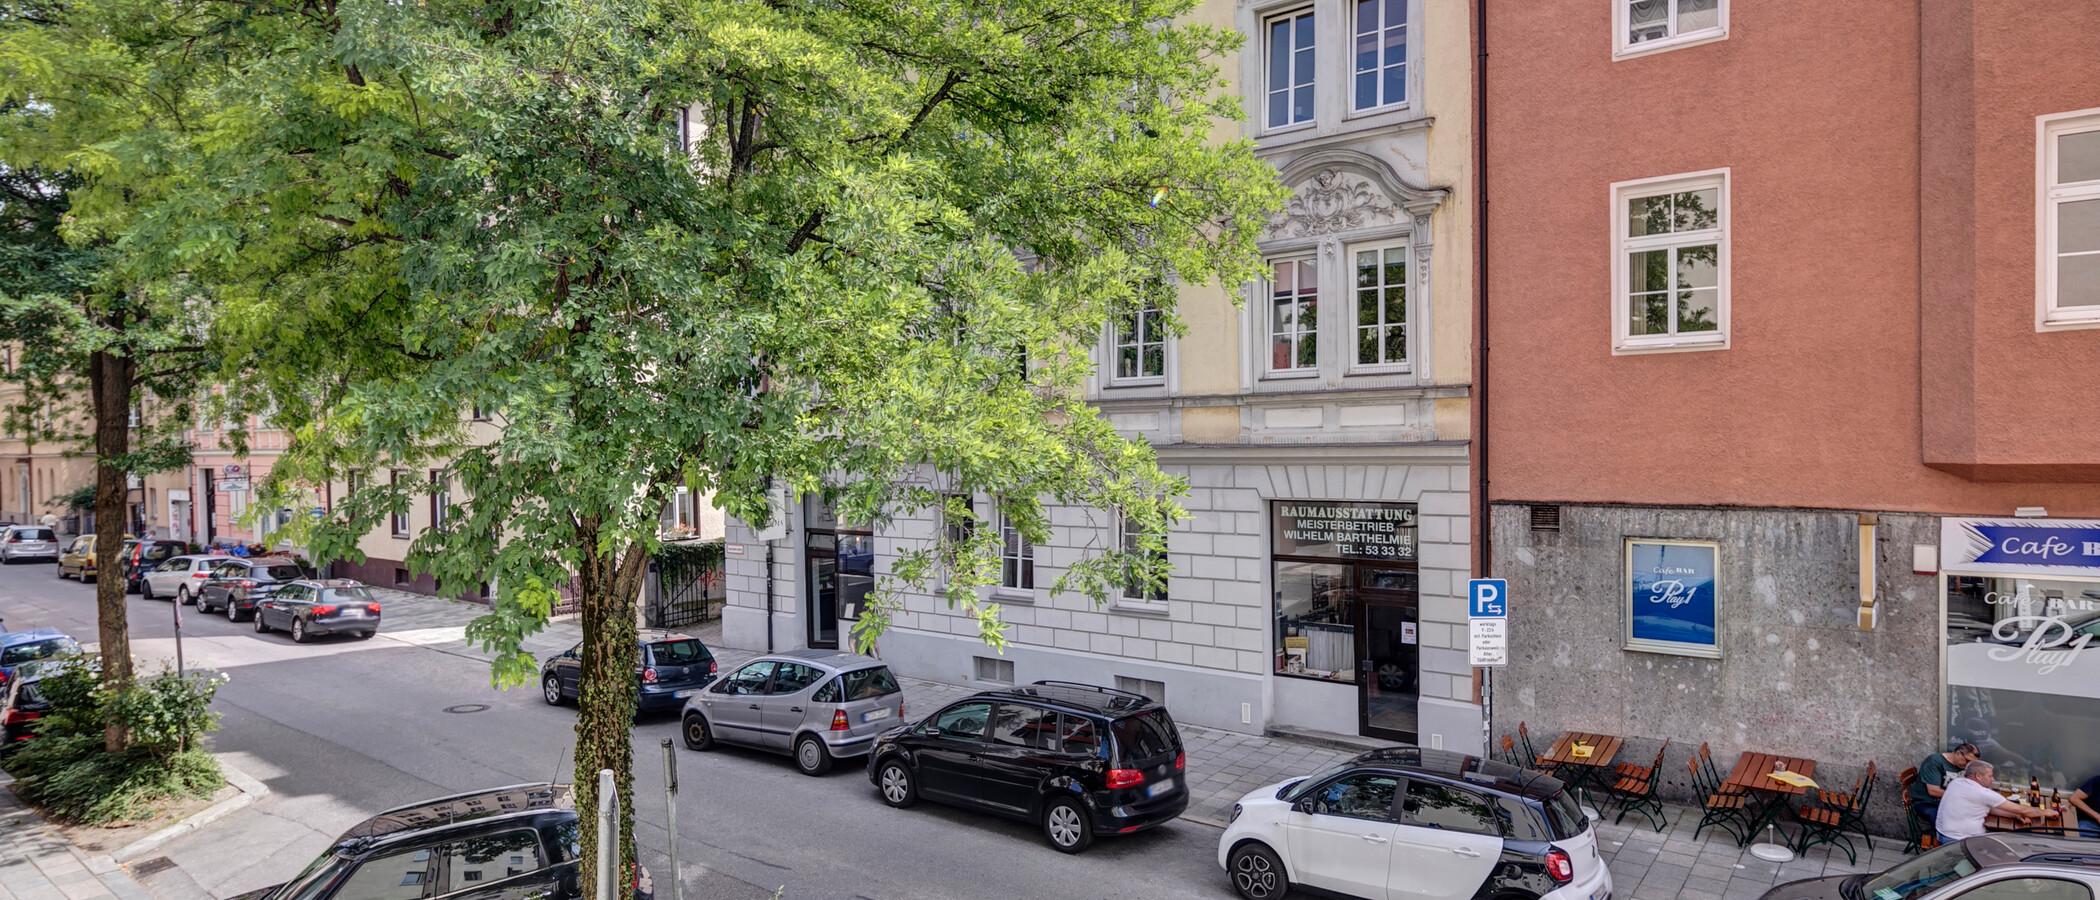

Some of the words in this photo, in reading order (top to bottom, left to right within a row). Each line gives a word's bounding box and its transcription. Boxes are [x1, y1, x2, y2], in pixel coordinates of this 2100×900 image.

[1281, 506, 1413, 521] RAUMAUSSTATTUNG
[1297, 519, 1395, 532] MEISTERBETRIEB
[1284, 530, 1334, 542] WILHELM
[1336, 532, 1411, 545] BARTHELMIE
[1335, 544, 1363, 555] TEL.:
[1365, 545, 1379, 555] 53
[1381, 546, 1395, 556] 33
[1397, 547, 1412, 557] 32
[2001, 536, 2075, 560] Cafe
[1653, 566, 1674, 575] Cafe
[1675, 567, 1695, 575] BAR
[1477, 584, 1498, 613] P
[1984, 591, 2036, 609] Cafe
[2047, 598, 2095, 611] BAR
